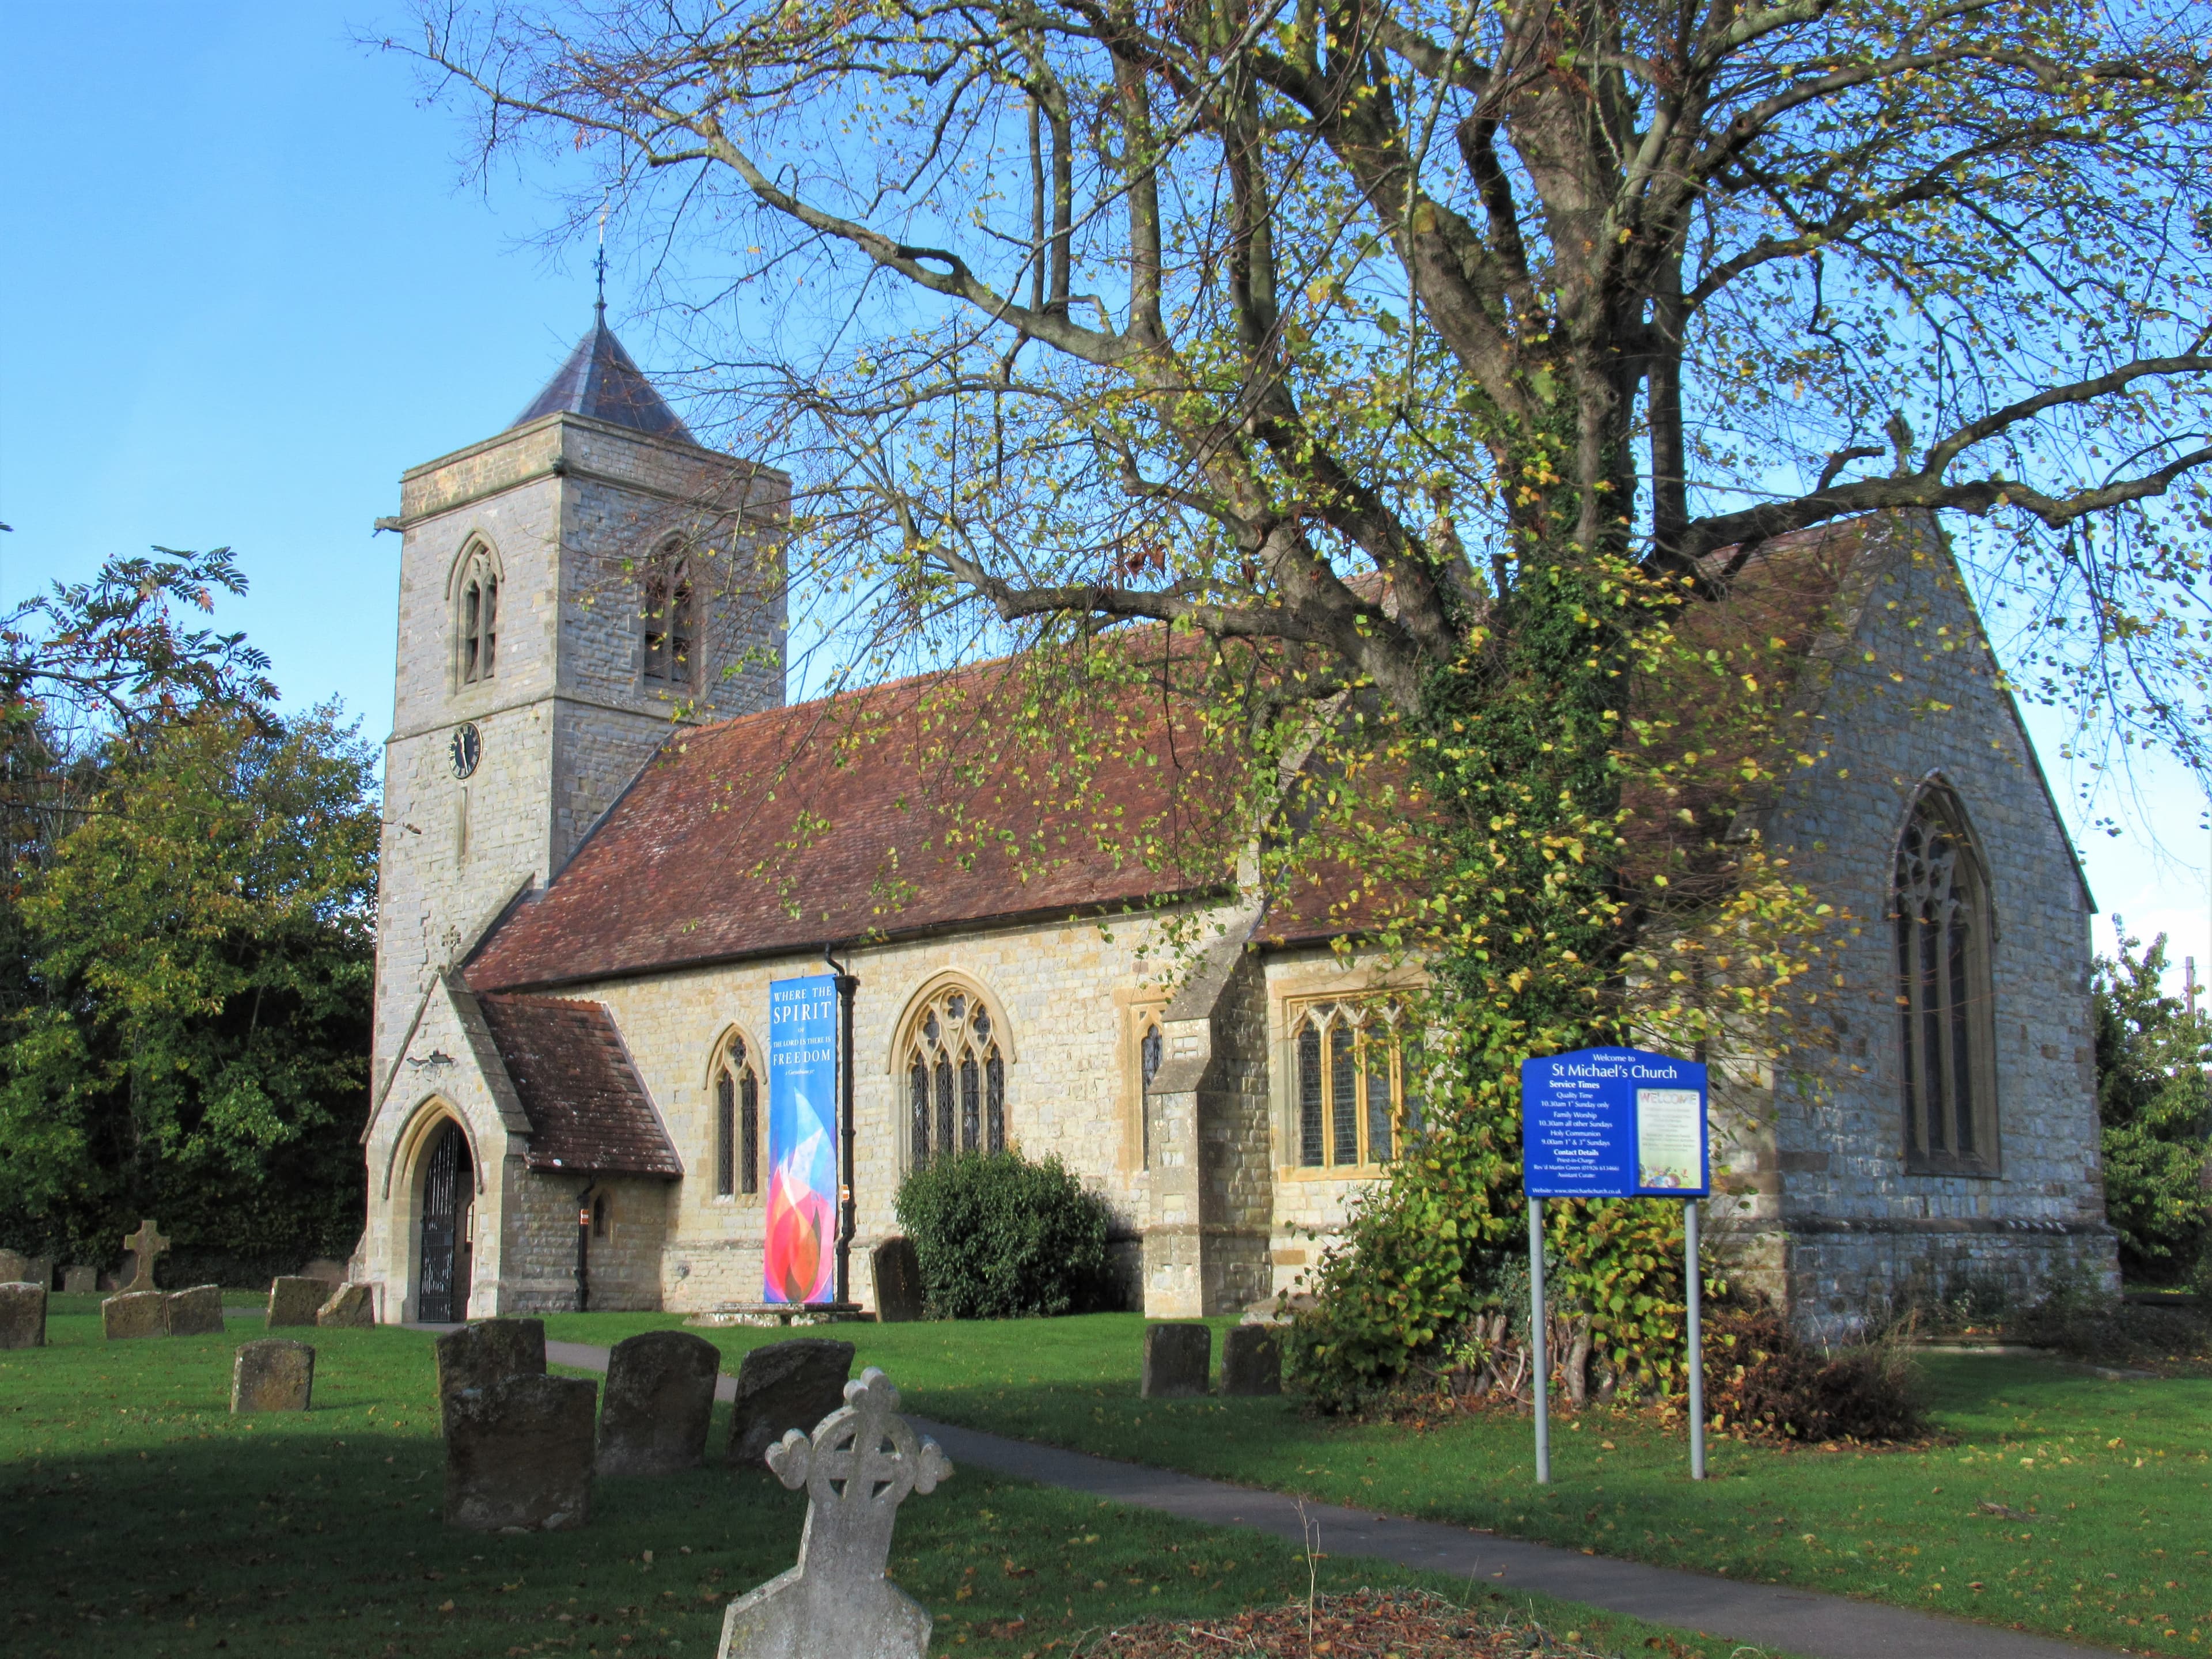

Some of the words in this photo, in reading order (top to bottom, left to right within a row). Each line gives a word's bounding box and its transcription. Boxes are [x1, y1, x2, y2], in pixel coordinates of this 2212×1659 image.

[774, 988, 806, 1002] WHERE
[812, 986, 832, 998] THE
[774, 1001, 832, 1024] SPIRIT
[783, 1039, 799, 1047] LORD
[807, 1036, 824, 1044] THERE
[774, 1048, 830, 1066] FREEDOM
[1593, 1054, 1626, 1062] Welcome
[1552, 1063, 1565, 1077] St
[1568, 1063, 1628, 1078] Michael's
[1632, 1065, 1677, 1080] Church
[1550, 1080, 1576, 1089] Service
[1578, 1081, 1600, 1089] Times
[1556, 1092, 1577, 1100] Quality
[1575, 1101, 1595, 1109] Sunday
[1597, 1101, 1609, 1109] only
[1554, 1111, 1571, 1119] Family
[1573, 1112, 1597, 1120] Worship
[1589, 1121, 1613, 1129] Sundays
[1587, 1139, 1611, 1147] Sundays
